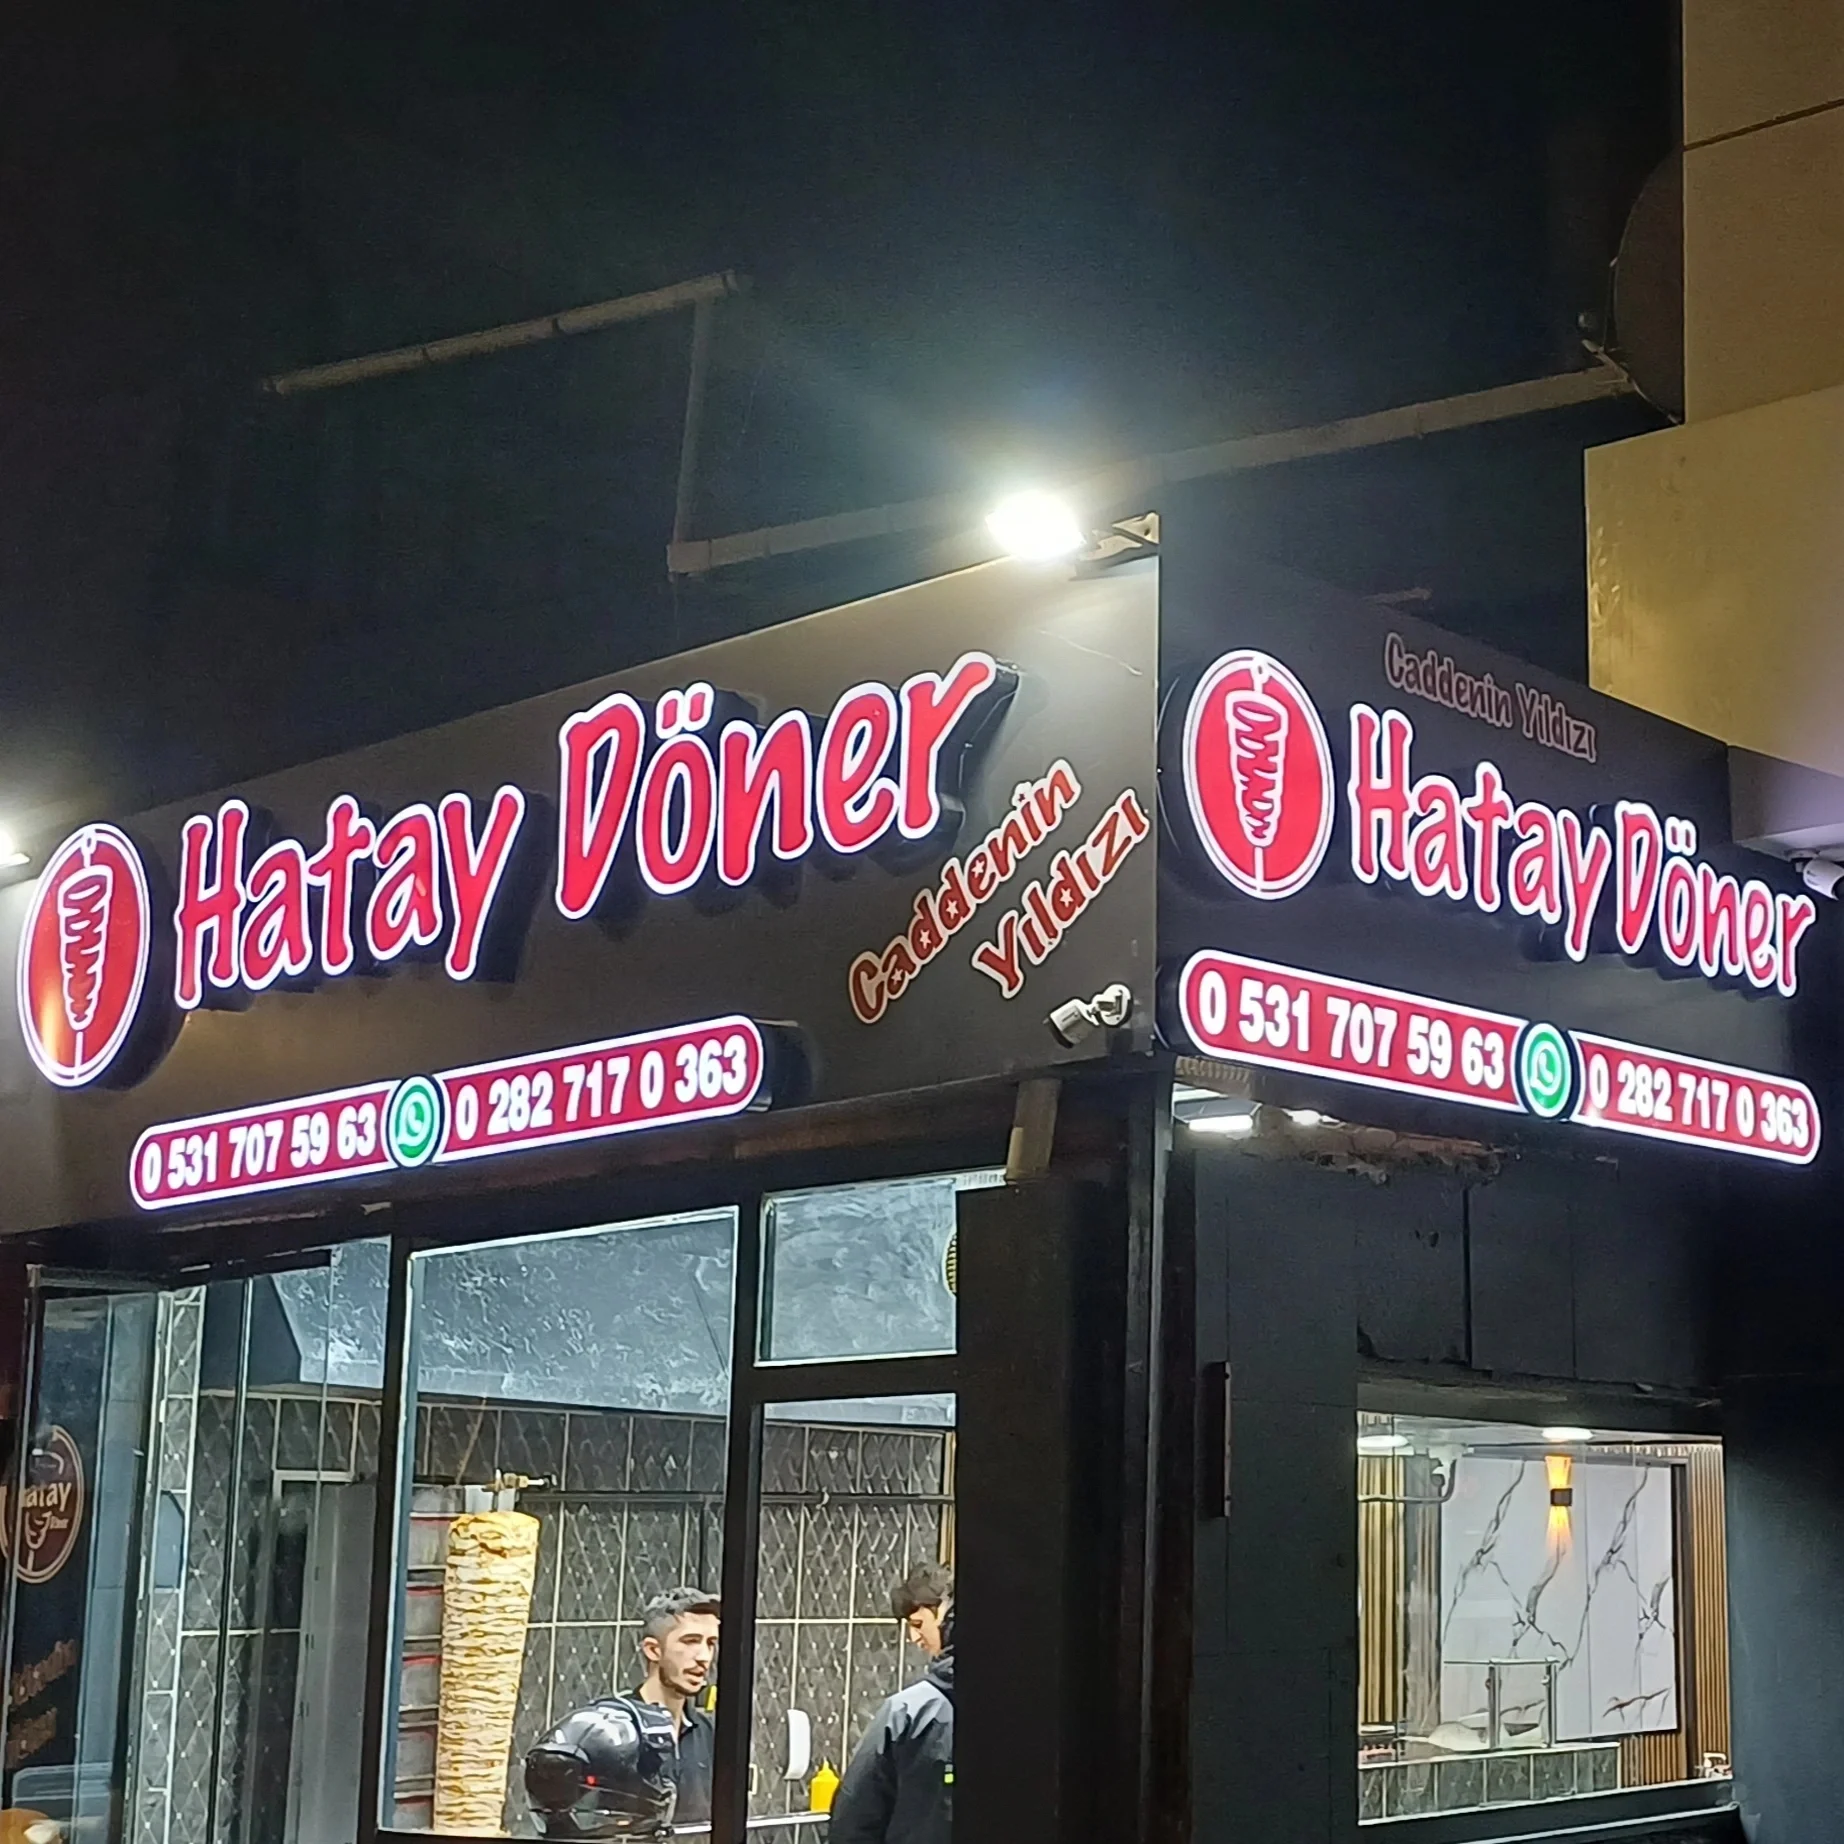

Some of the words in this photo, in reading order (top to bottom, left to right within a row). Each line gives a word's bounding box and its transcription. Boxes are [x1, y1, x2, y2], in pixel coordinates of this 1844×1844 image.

[1385, 632, 1513, 728] Caddenin
[173, 786, 525, 1010] Hatay
[555, 650, 997, 920] Döner
[1347, 702, 1613, 963] Hatay
[1615, 800, 1816, 998] Döner
[849, 758, 1082, 1025] Caddenin
[1199, 970, 1228, 1036] 0
[1238, 977, 1311, 1053] 531
[1326, 995, 1398, 1069] 707
[1406, 1014, 1453, 1080] 59
[1460, 1026, 1505, 1090] 63
[455, 1084, 480, 1141] 0
[486, 1070, 554, 1137] 282
[562, 1055, 631, 1123] 717
[639, 1050, 665, 1110] 0
[674, 1034, 748, 1104] 363
[1588, 1053, 1610, 1110] 0
[1617, 1059, 1674, 1123] 282
[1677, 1071, 1731, 1133] 717
[1735, 1085, 1756, 1138] 0
[1760, 1090, 1810, 1149] 363
[141, 1142, 163, 1194] 0
[166, 1130, 219, 1190] 531
[228, 1118, 285, 1179] 707
[289, 1111, 330, 1166] 59
[336, 1101, 377, 1160] 63
